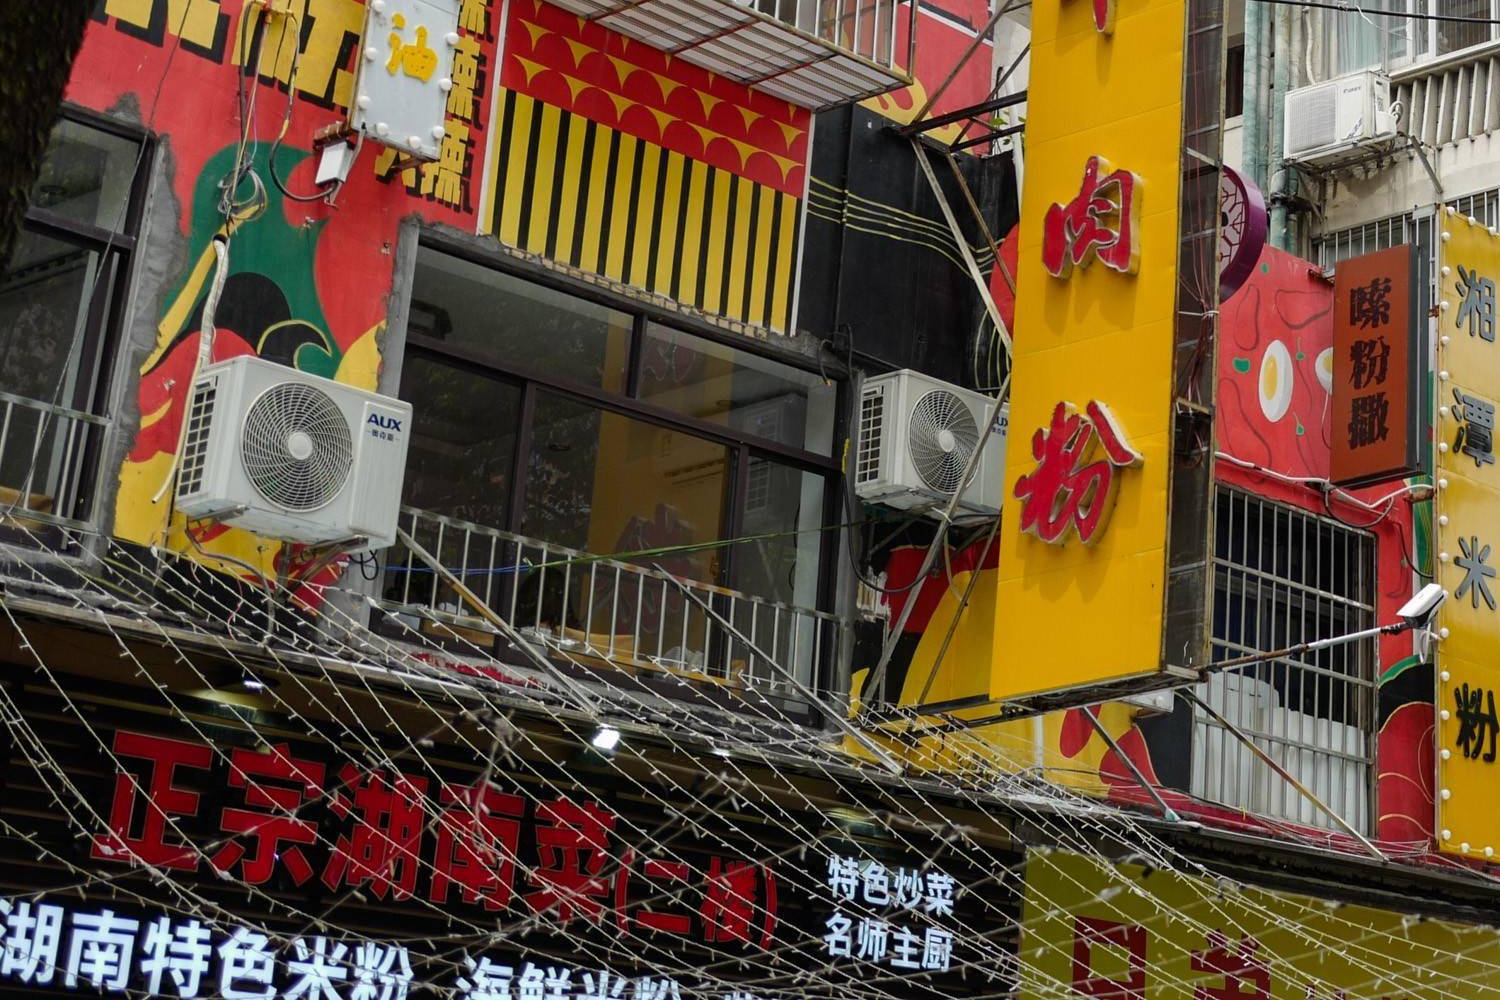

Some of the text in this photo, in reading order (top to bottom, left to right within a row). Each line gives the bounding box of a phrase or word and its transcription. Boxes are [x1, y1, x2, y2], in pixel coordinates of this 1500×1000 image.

[367, 413, 402, 432] AUX
[1452, 264, 1500, 764] 湘潭米粉
[826, 853, 956, 917] 特色炒菜
[0, 902, 415, 1000] 湖南特色米粉
[824, 912, 953, 972] 名师主厨
